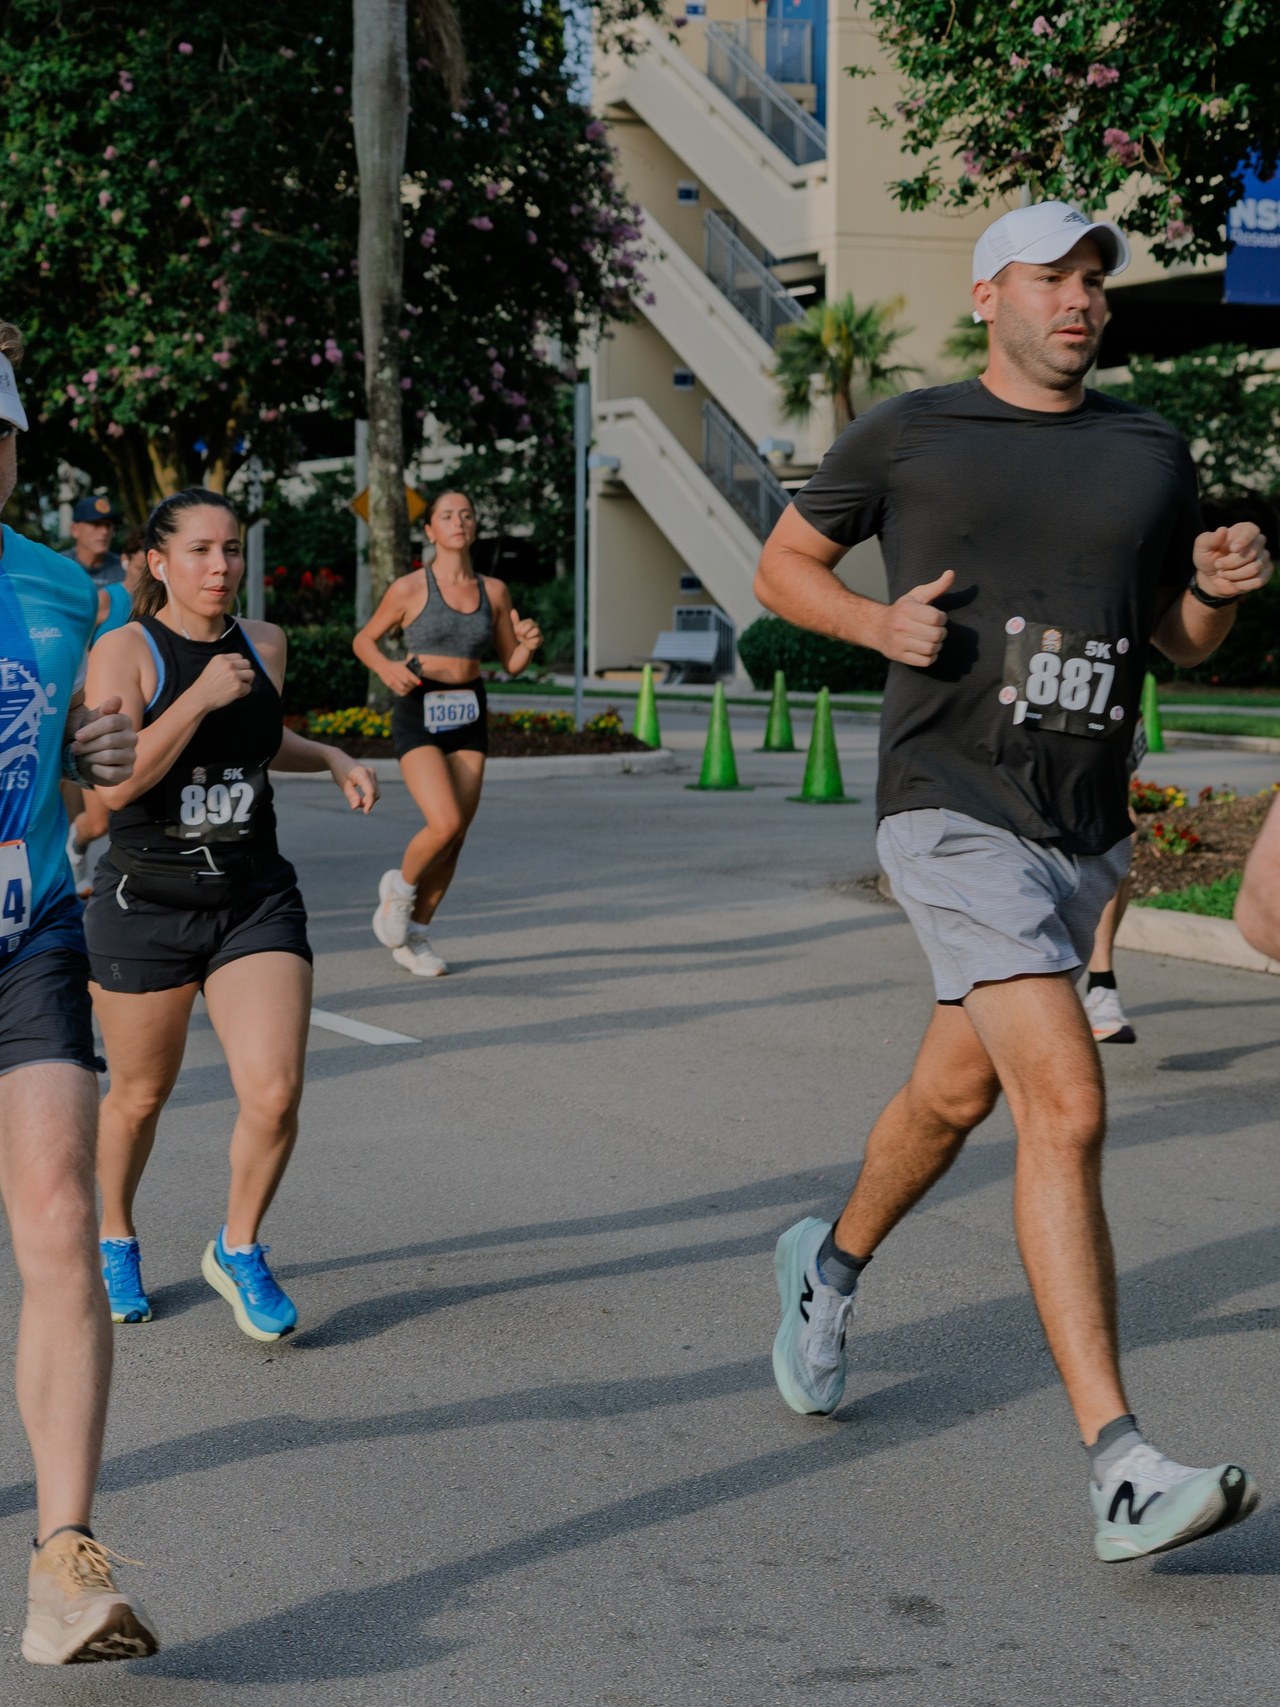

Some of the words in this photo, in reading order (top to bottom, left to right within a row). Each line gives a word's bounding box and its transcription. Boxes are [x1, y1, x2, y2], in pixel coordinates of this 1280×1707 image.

[1229, 198, 1280, 230] NS
[1084, 640, 1112, 660] 5K
[1025, 652, 1116, 715] 887
[428, 703, 476, 722] 13678
[222, 767, 244, 781] 5K
[180, 782, 255, 826] 892
